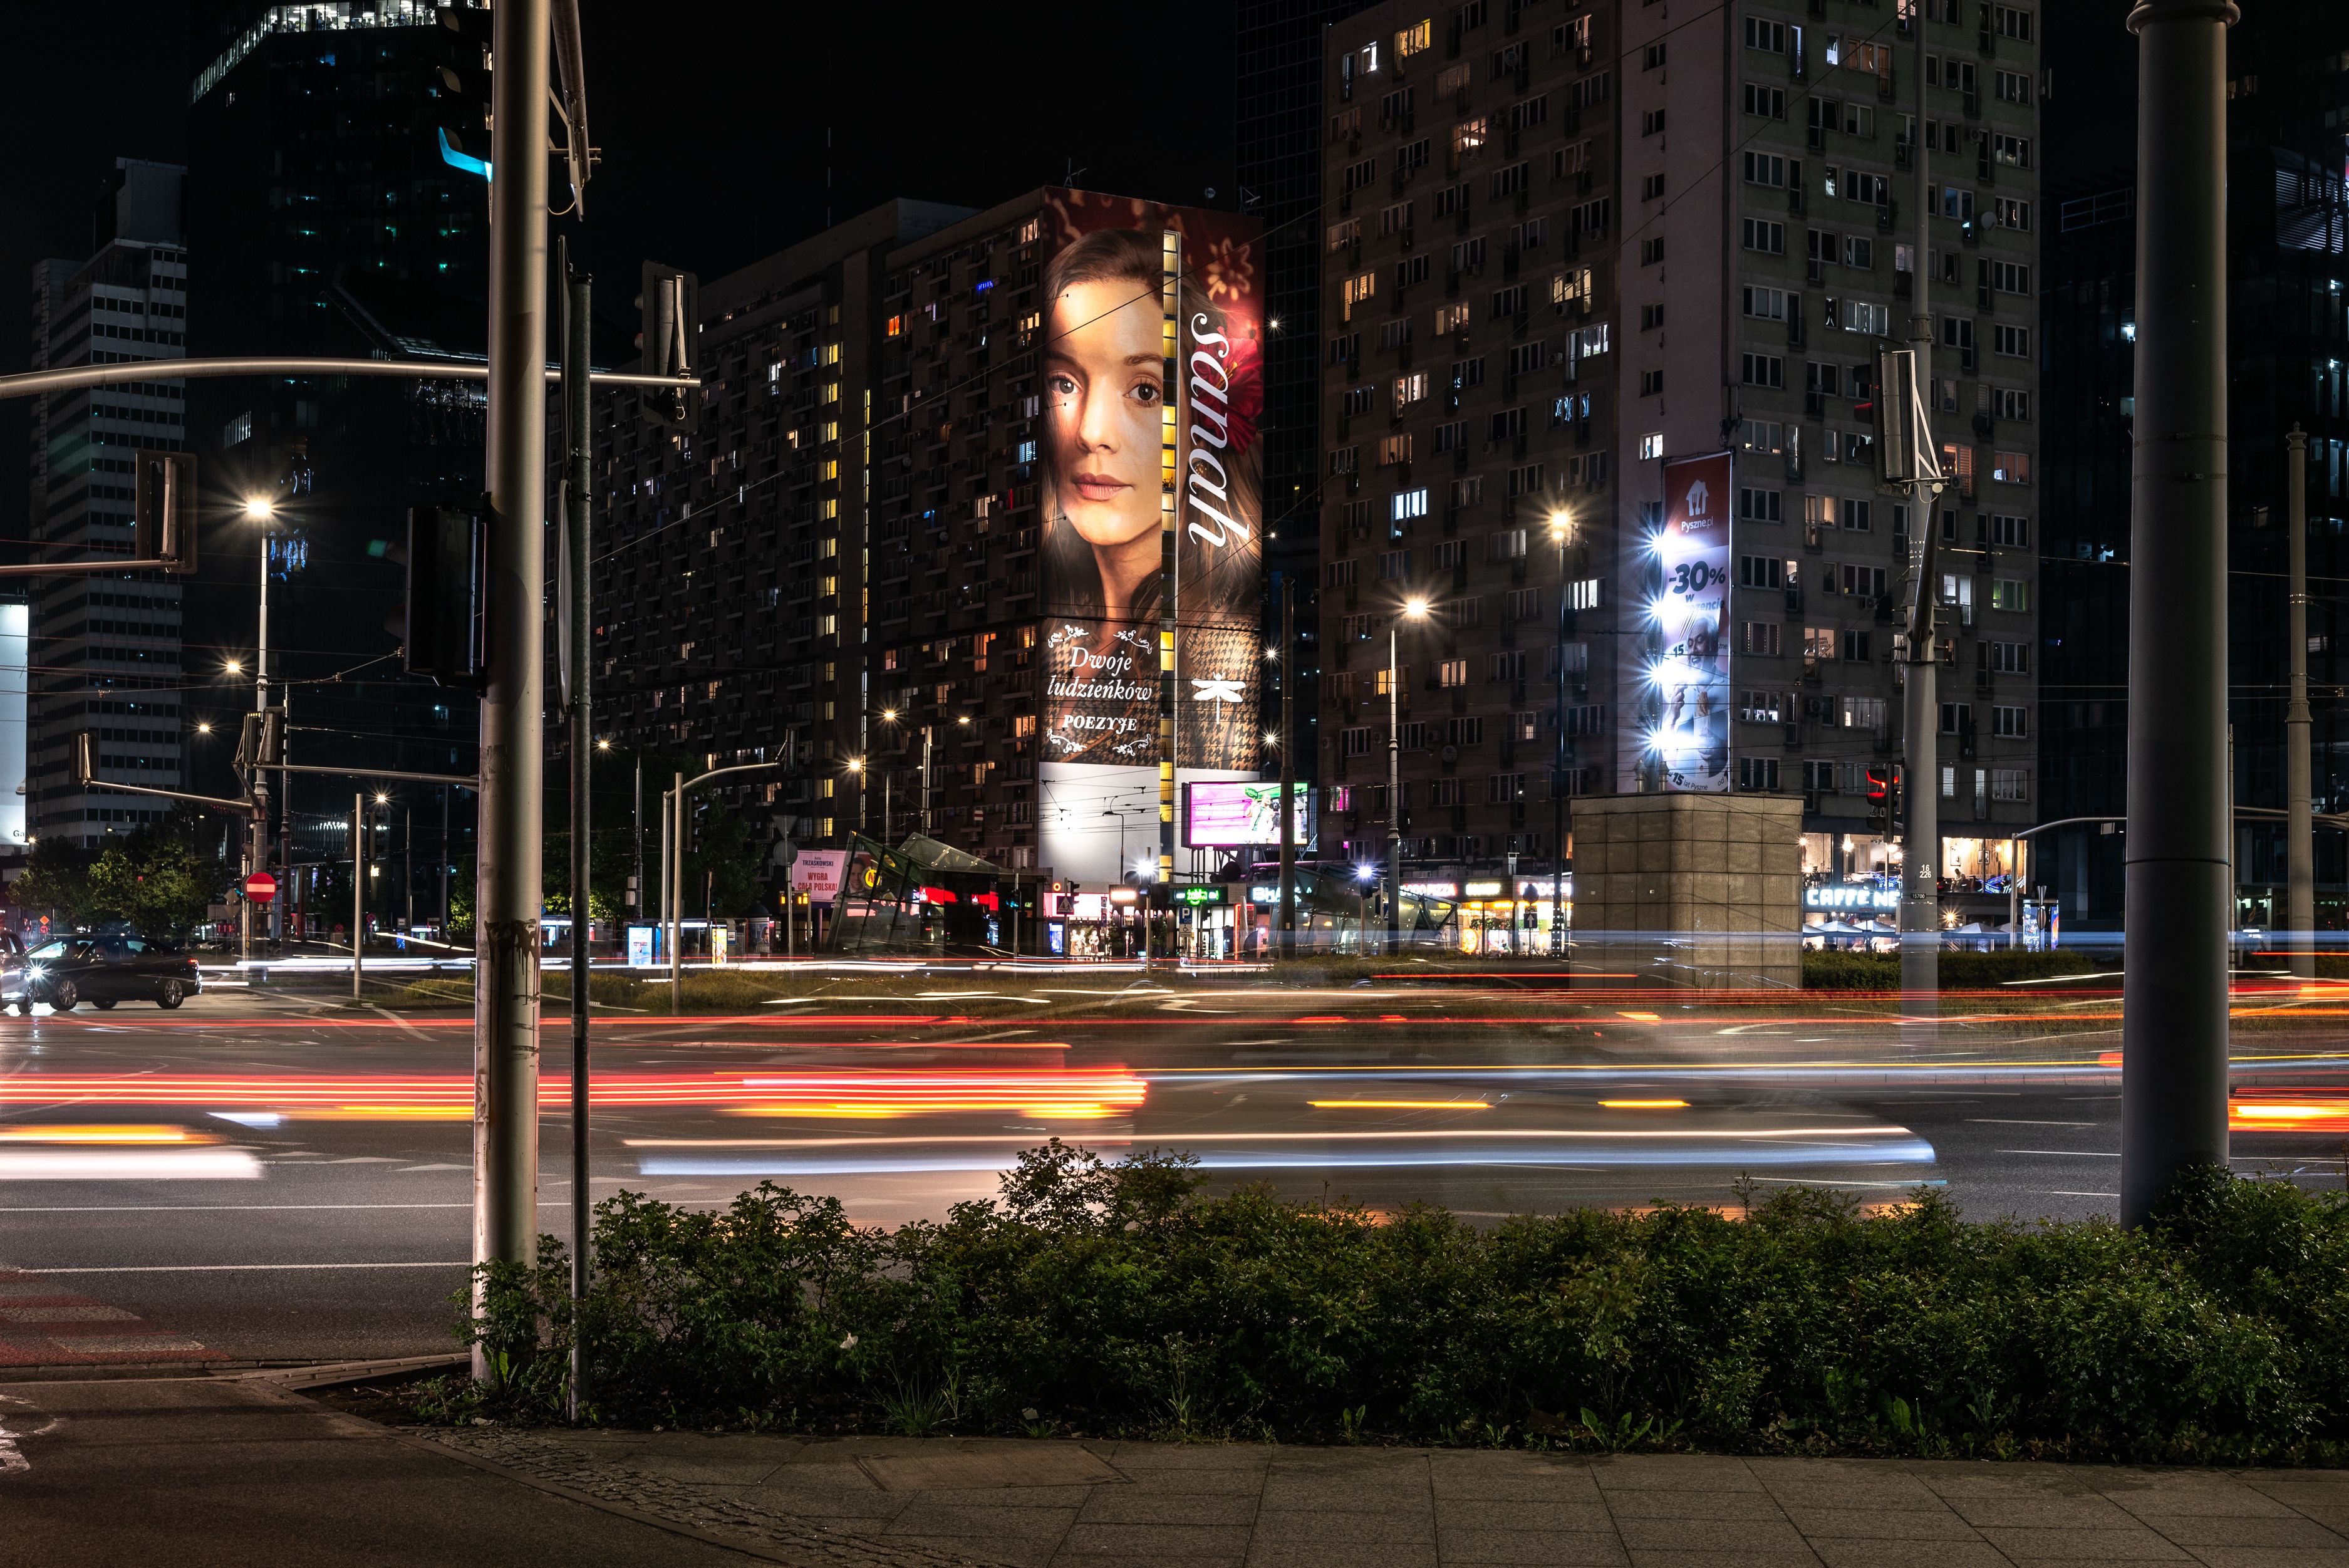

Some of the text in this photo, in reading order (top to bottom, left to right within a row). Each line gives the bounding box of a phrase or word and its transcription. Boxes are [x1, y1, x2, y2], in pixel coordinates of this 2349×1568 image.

[1188, 313, 1250, 548] sanah
[1681, 516, 1713, 532] Pyszne.pl
[1669, 561, 1726, 594] -30%
[1685, 594, 1695, 602] w
[1069, 646, 1133, 677] Dwoje
[1047, 675, 1153, 700] ludzieńków
[1062, 714, 1138, 734] POEZYJE
[1672, 772, 1684, 786] 15
[1691, 782, 1708, 791] Pyszne
[1717, 776, 1724, 786] od
[807, 872, 828, 881] WYGRA
[797, 882, 837, 891] CAŁA POLSKA!
[1182, 908, 1190, 919] P
